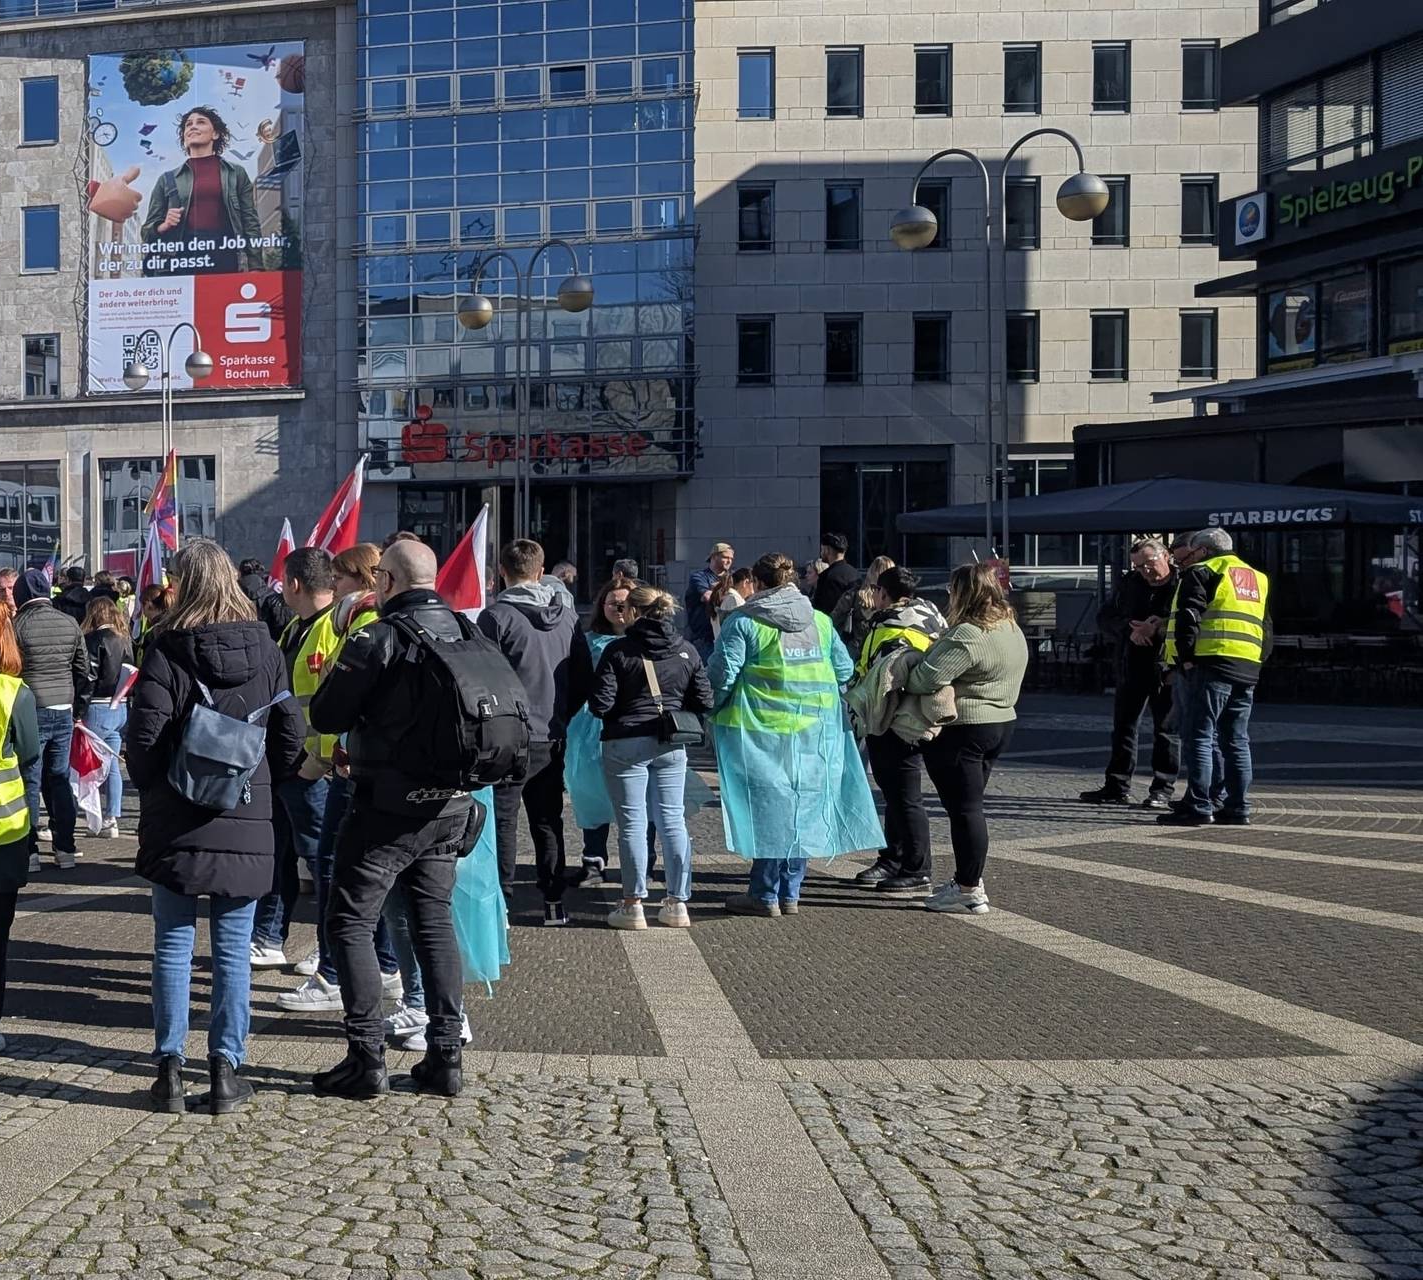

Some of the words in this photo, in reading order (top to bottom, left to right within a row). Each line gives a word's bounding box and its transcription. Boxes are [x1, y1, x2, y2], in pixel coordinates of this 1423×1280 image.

[98, 242, 124, 255] Wir
[128, 239, 184, 253] machen
[188, 237, 215, 251] den
[219, 235, 246, 250] Job
[249, 233, 291, 248] wahr,
[98, 259, 123, 272] der
[126, 260, 143, 270] zu
[147, 257, 167, 270] dir
[170, 255, 215, 272] passt.
[114, 290, 131, 298] Job,
[133, 289, 146, 297] der
[148, 288, 165, 296] dich
[127, 298, 179, 307] weiterbringt.
[219, 354, 276, 368] Sparkasse
[225, 368, 270, 379] Bochum
[1208, 508, 1334, 526] STARBUCKS
[1409, 509, 1423, 523] ST
